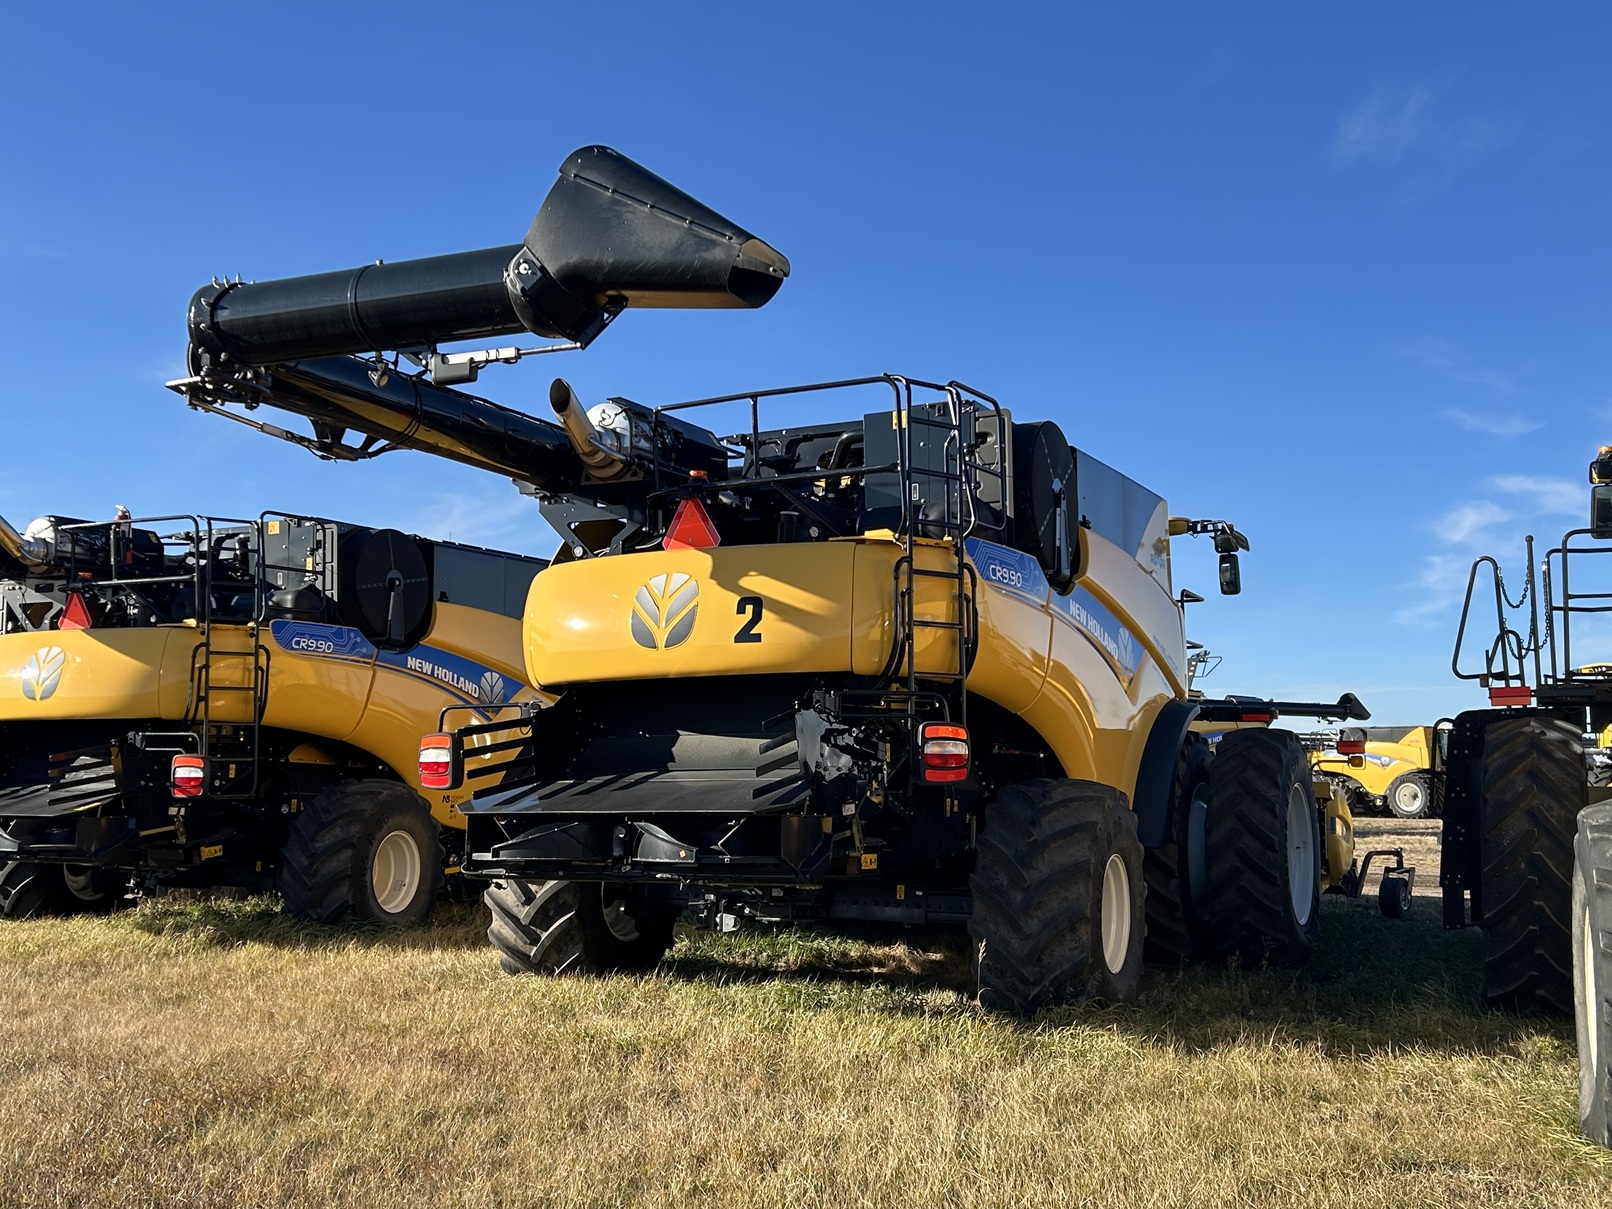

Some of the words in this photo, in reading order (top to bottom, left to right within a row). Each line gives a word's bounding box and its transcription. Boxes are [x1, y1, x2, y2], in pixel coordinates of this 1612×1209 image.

[990, 564, 1023, 588] CR9.90
[734, 596, 763, 643] 2
[1069, 598, 1087, 626] NEW
[1087, 613, 1119, 661] HOLLAND
[292, 637, 334, 653] CR9.90
[407, 656, 433, 675] NEW
[433, 664, 479, 698] HOLLAND
